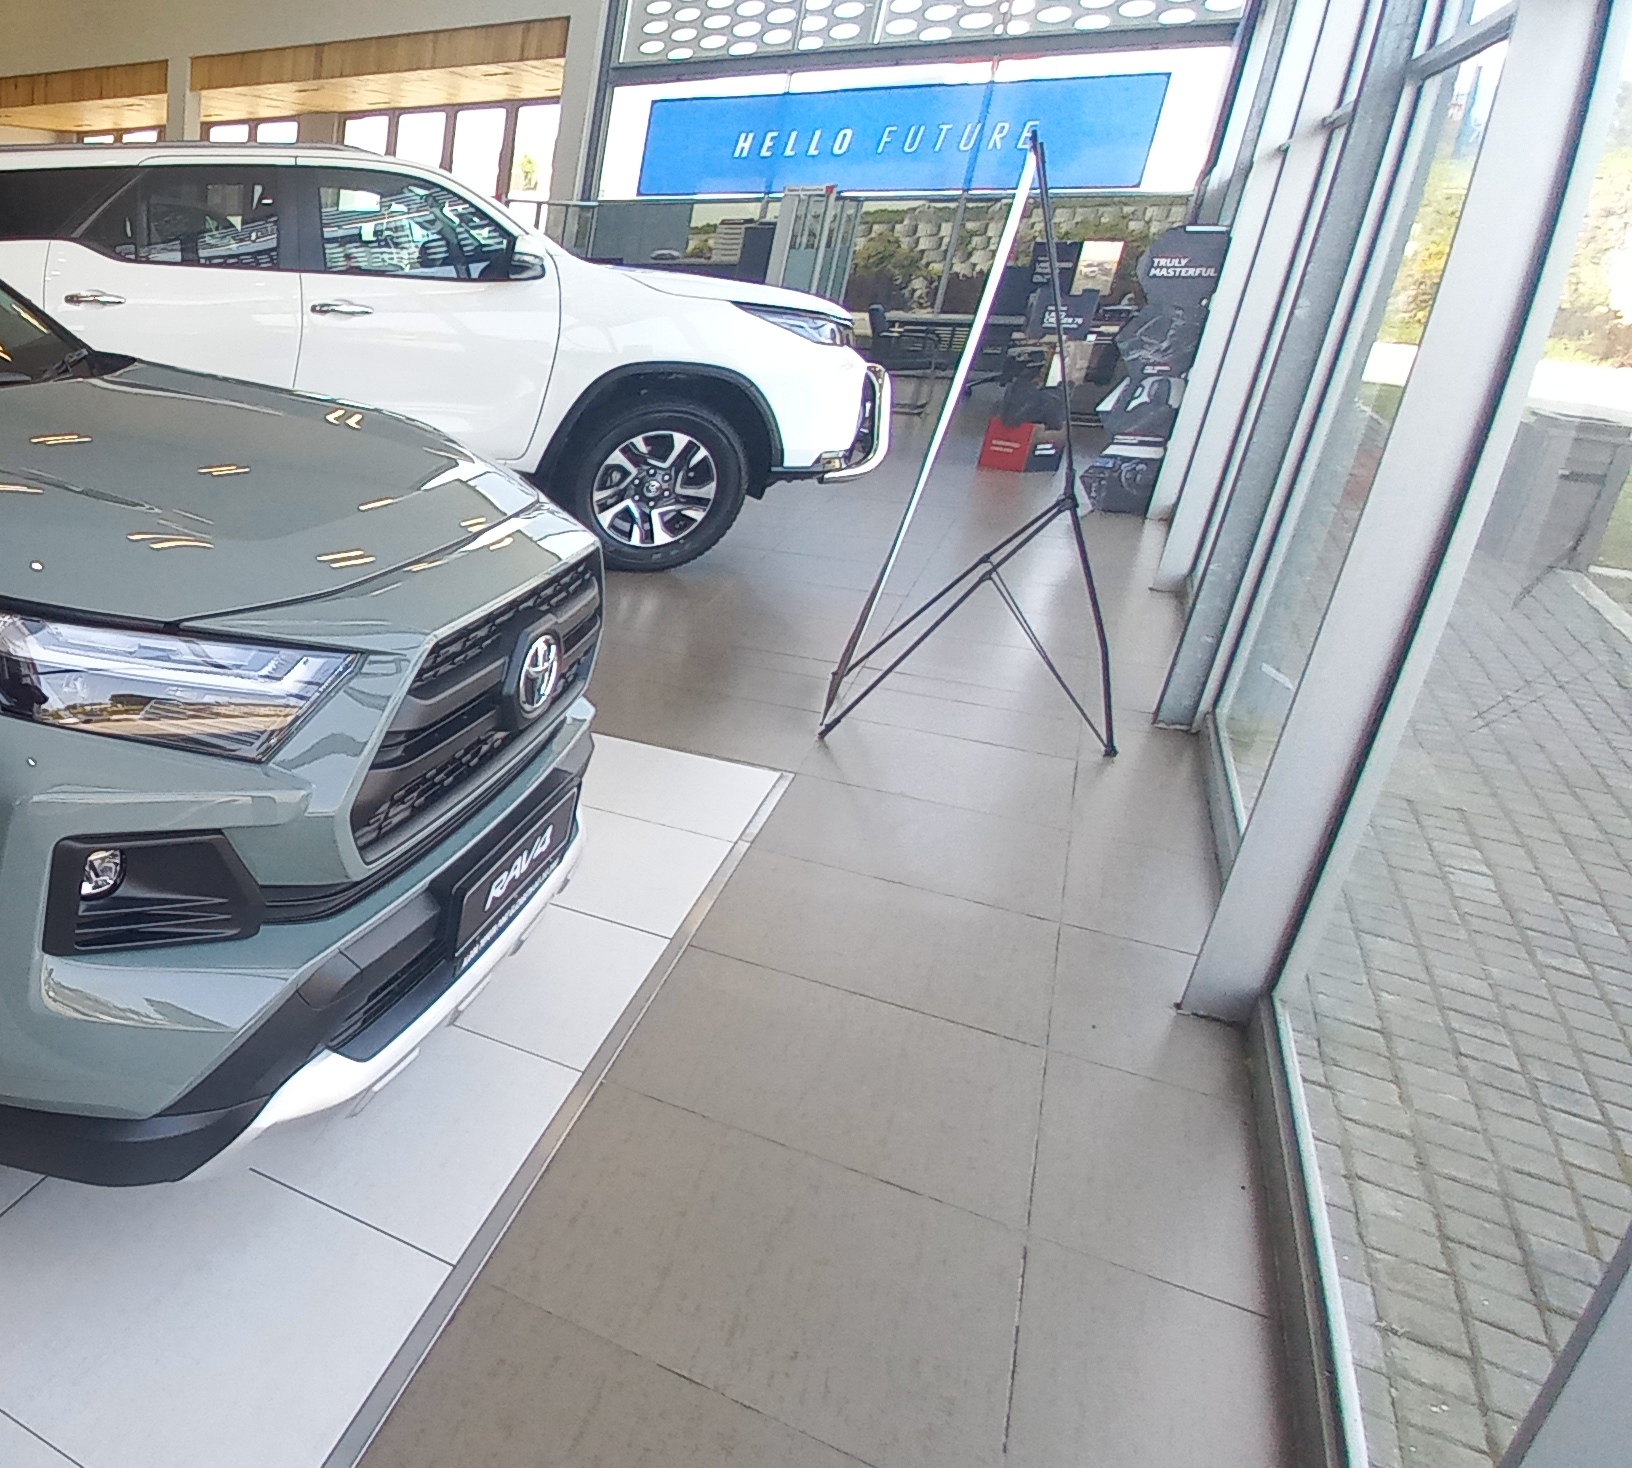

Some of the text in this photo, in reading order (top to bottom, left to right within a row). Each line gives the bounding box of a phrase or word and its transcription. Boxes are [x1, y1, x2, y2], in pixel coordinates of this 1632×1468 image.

[733, 120, 1040, 158] HELLO FUTURE
[1149, 267, 1218, 277] MASTERFUL
[1153, 257, 1190, 267] TRULY
[484, 824, 554, 912] RAV4
